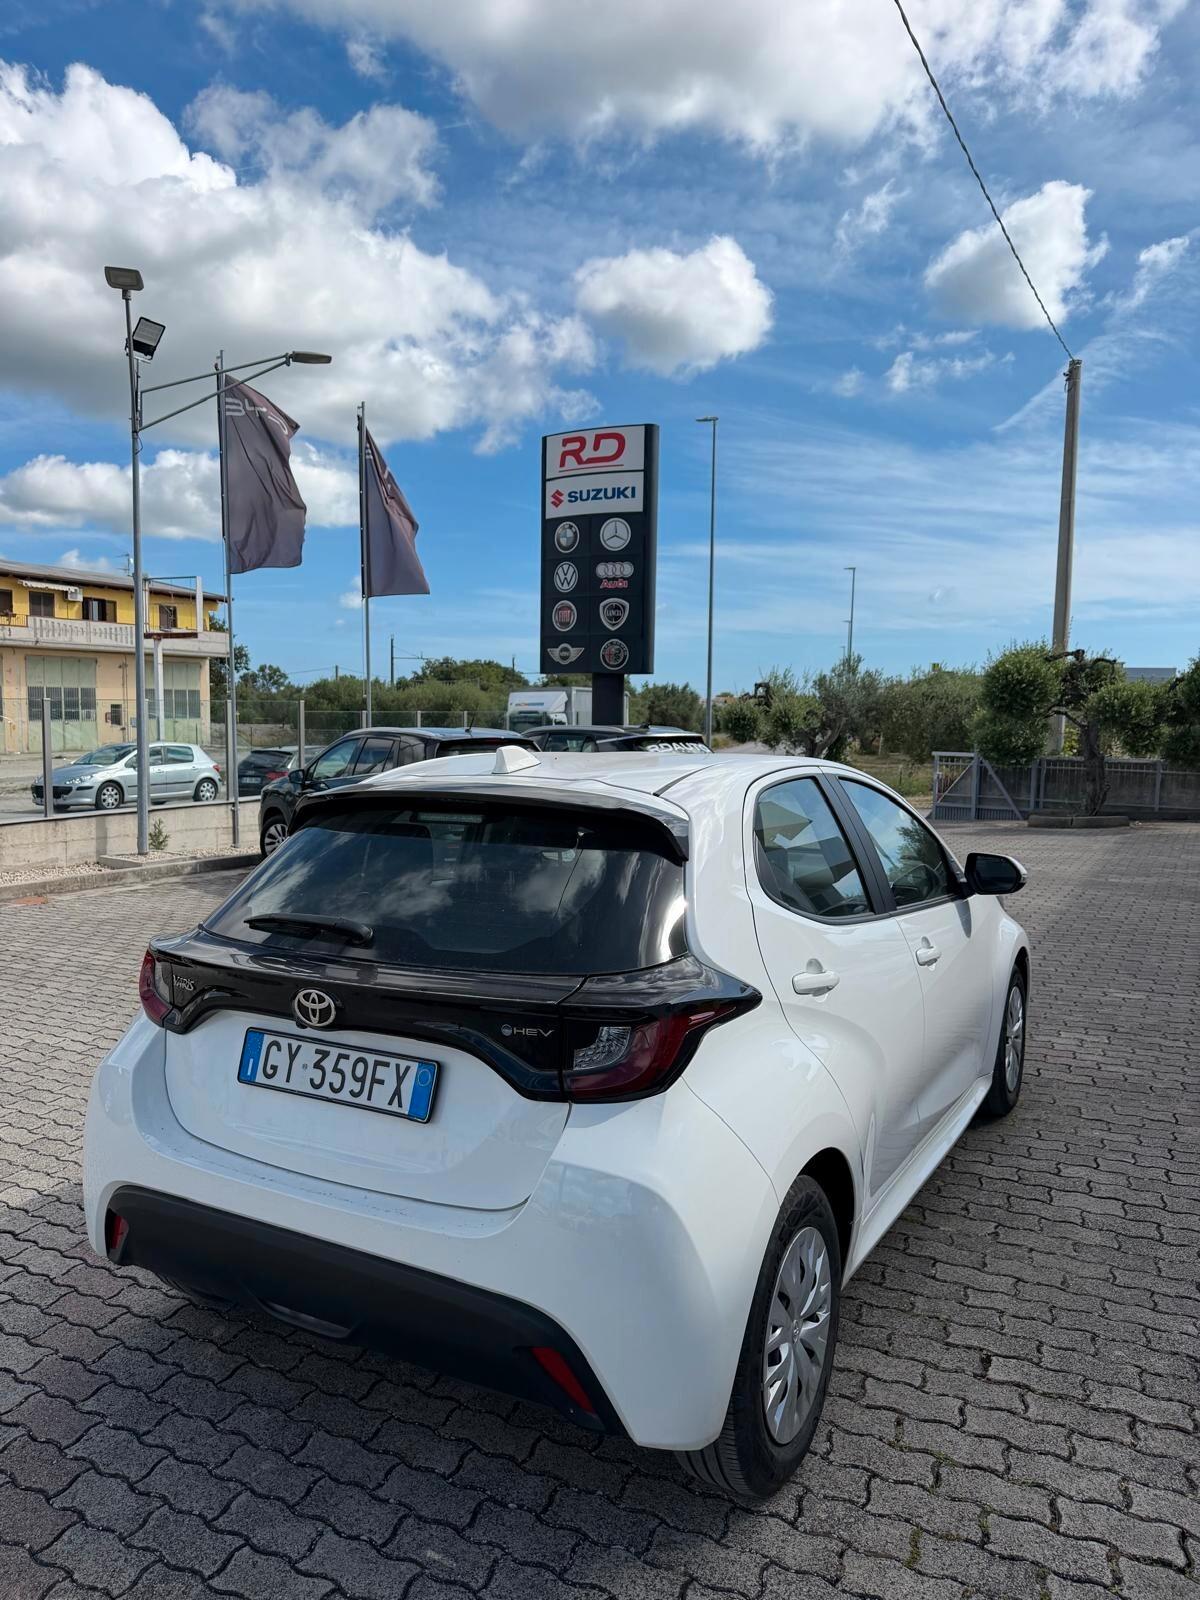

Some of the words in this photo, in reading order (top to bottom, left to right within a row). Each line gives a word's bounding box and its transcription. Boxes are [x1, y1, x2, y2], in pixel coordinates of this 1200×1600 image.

[559, 432, 626, 468] RD
[567, 486, 636, 504] SUZUKI
[513, 1027, 555, 1037] HEV
[262, 1039, 302, 1083] GY
[309, 1048, 412, 1108] 359FX
